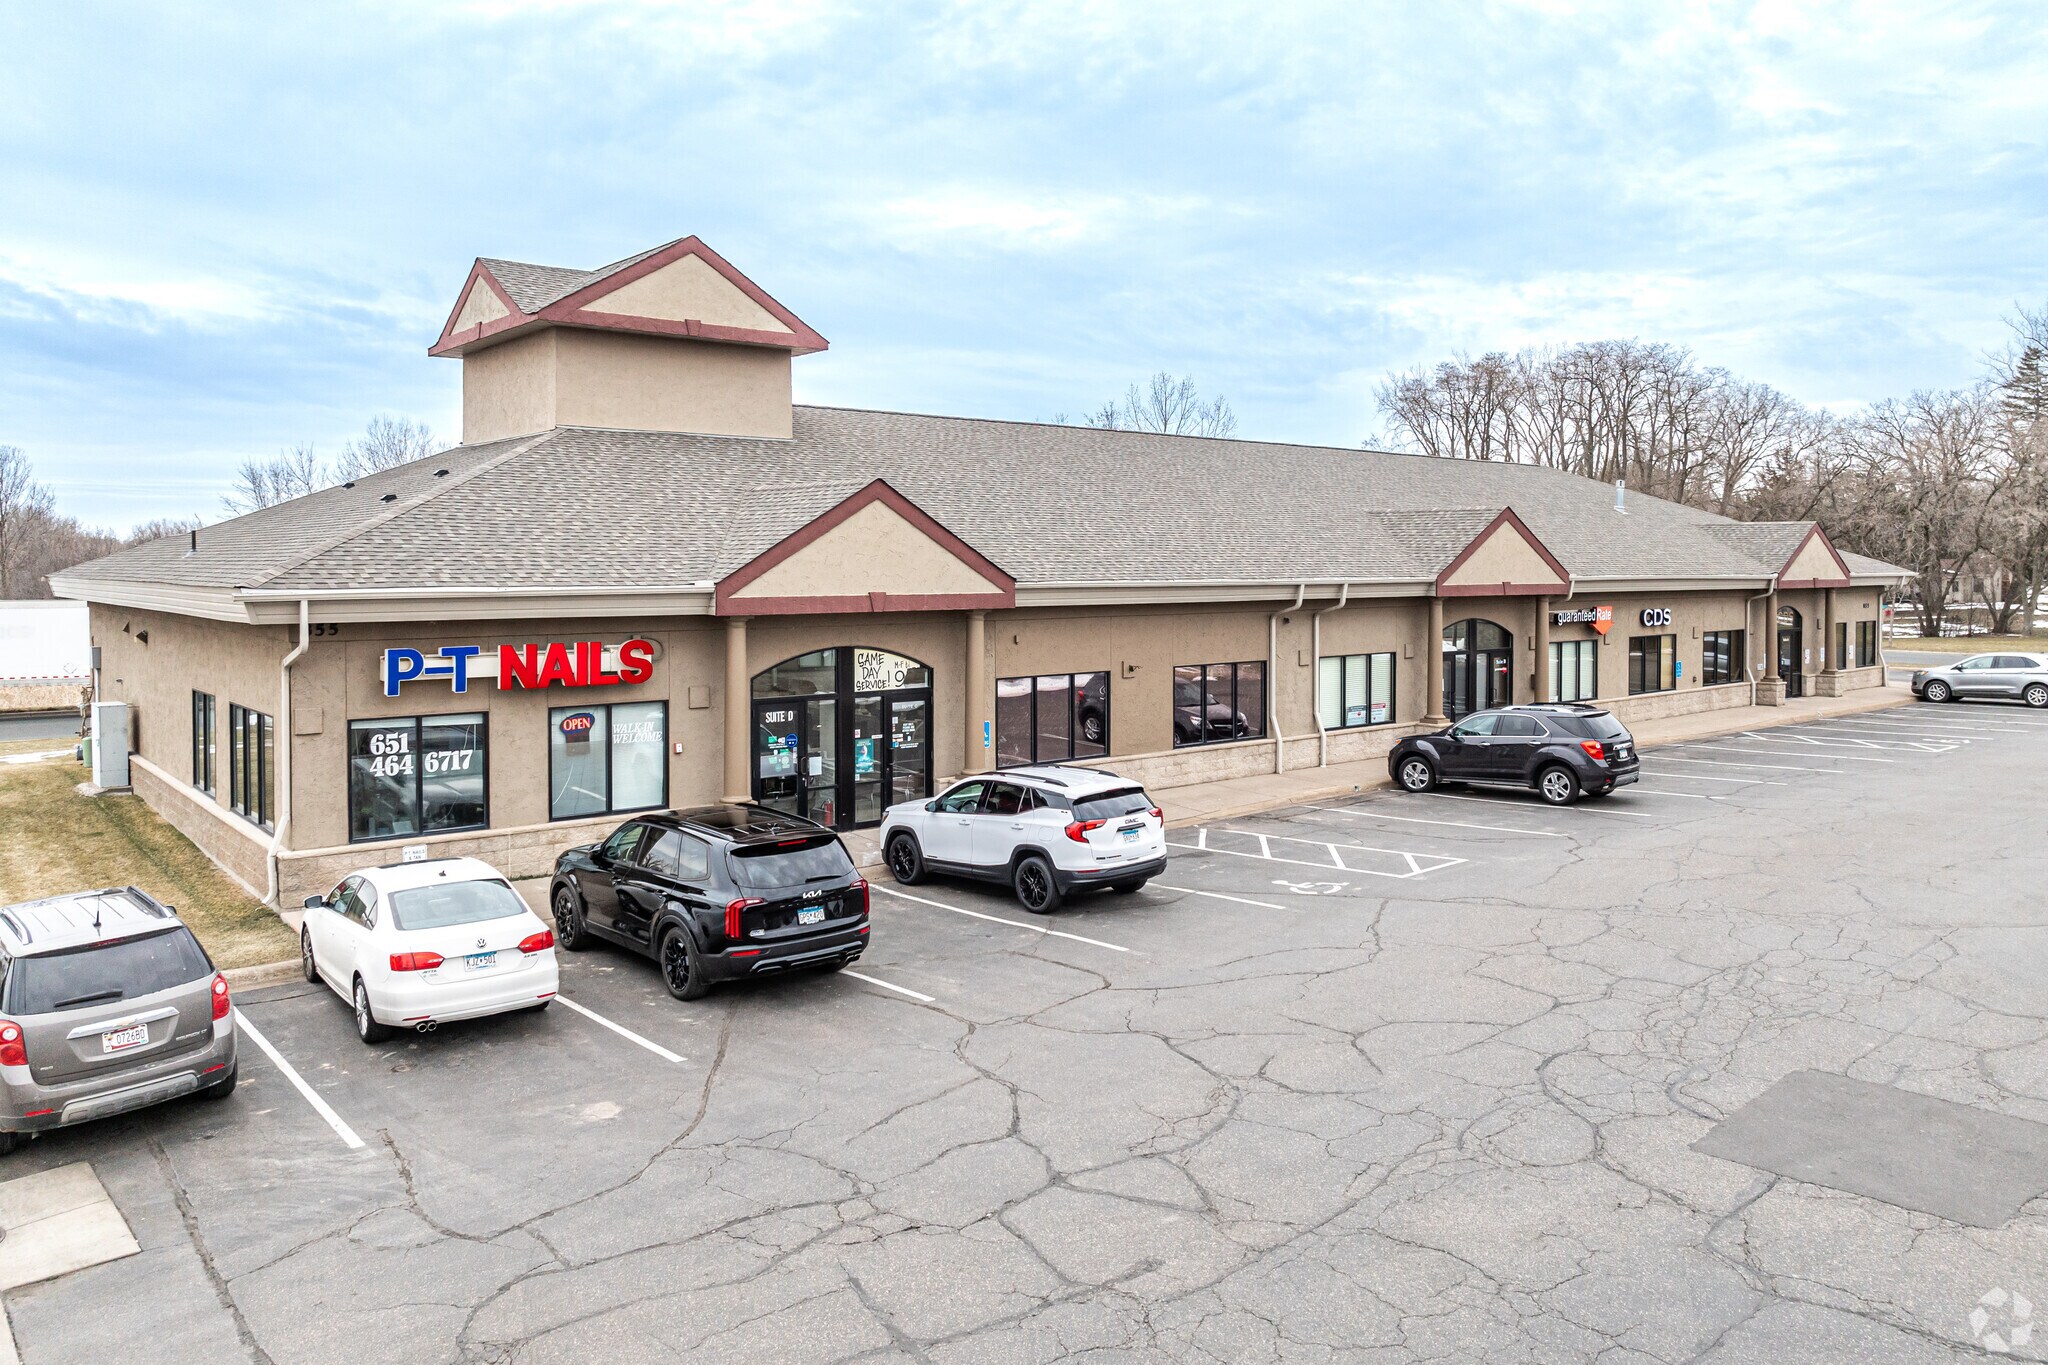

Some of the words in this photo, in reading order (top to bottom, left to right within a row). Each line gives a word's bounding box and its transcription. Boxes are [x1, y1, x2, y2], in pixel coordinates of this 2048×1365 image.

[1558, 608, 1596, 626] guaranteed
[1596, 608, 1612, 621] Rate
[1643, 608, 1672, 627] CDS
[308, 623, 339, 637] 55
[498, 639, 654, 690] NAILS
[857, 652, 885, 667] SAME
[861, 665, 882, 680] DAY
[563, 717, 591, 731] OPEN
[765, 711, 785, 723] SUITE
[788, 710, 794, 722] D
[613, 721, 655, 734] WALK-IN
[369, 732, 410, 756] 651
[612, 731, 663, 744] WELCOME
[369, 754, 415, 778] 464
[424, 749, 474, 773] 6717
